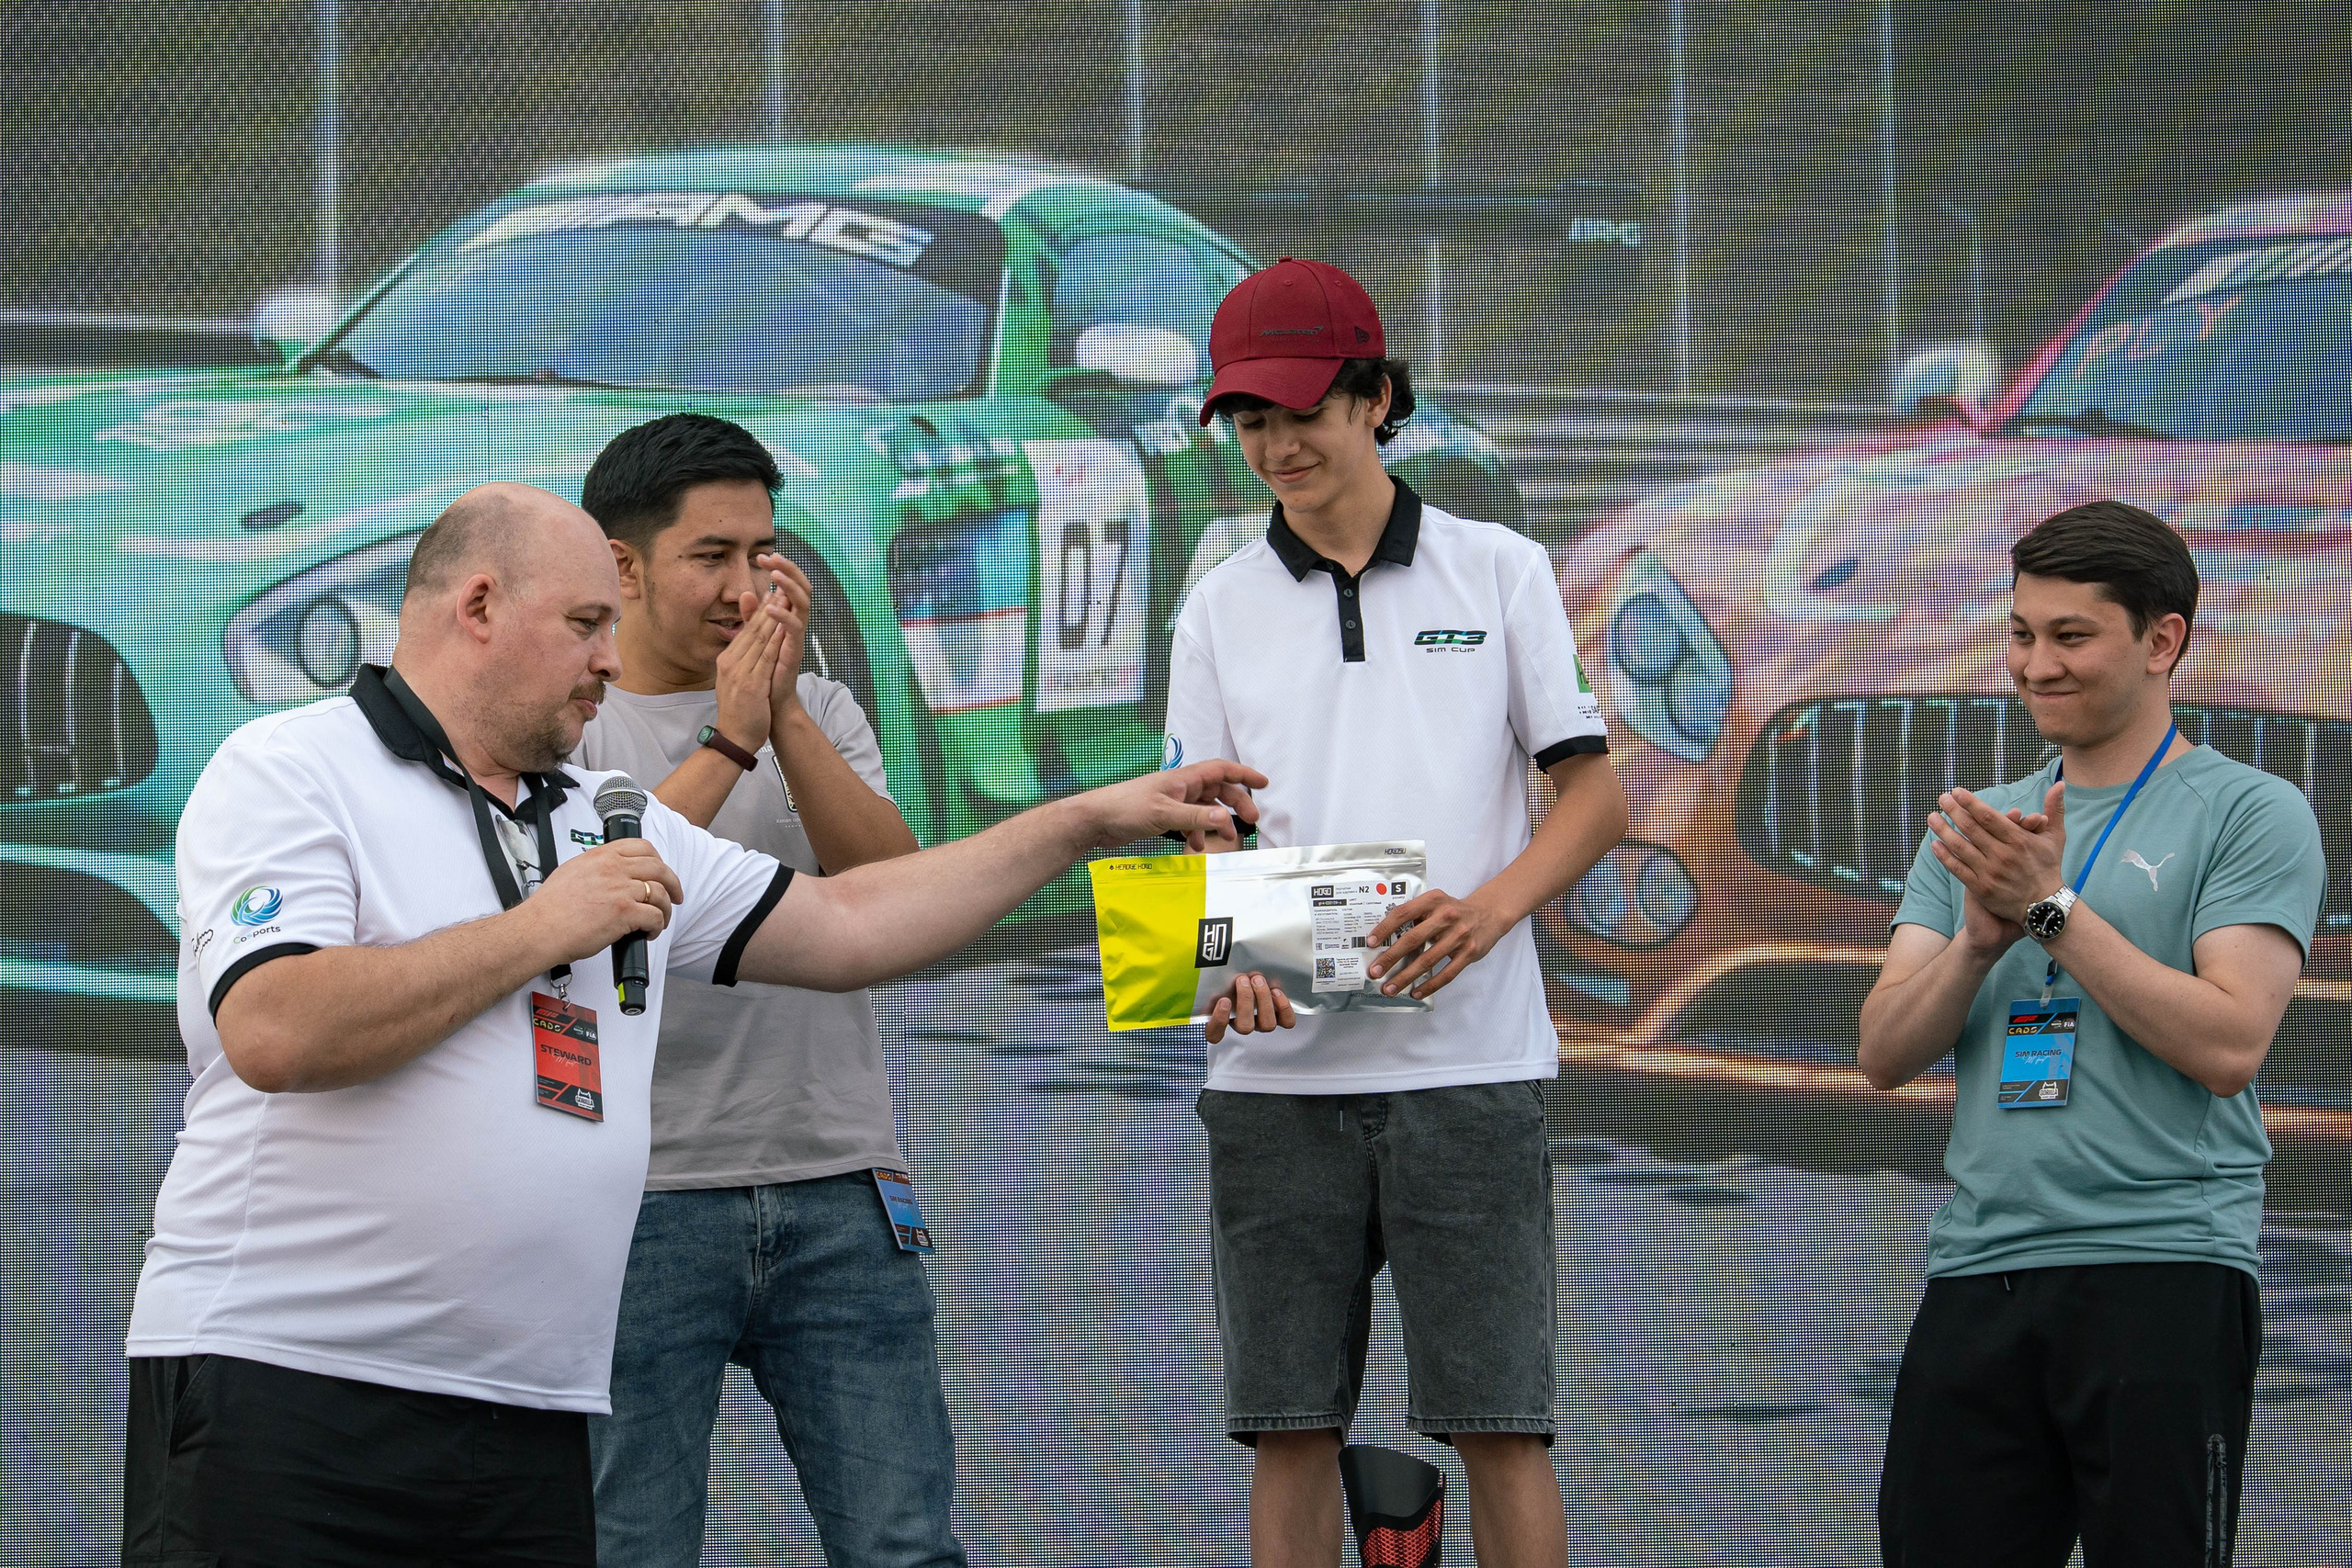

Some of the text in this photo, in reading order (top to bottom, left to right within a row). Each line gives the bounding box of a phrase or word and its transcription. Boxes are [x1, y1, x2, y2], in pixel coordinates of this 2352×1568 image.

[1057, 520, 1130, 650] 07
[1414, 630, 1487, 645] GT3
[571, 829, 605, 846] GT
[1313, 887, 1331, 897] HOGO
[1359, 886, 1370, 894] N2
[1395, 884, 1402, 893] S
[540, 1043, 592, 1066] STEWARD
[2030, 1048, 2063, 1056] RACING
